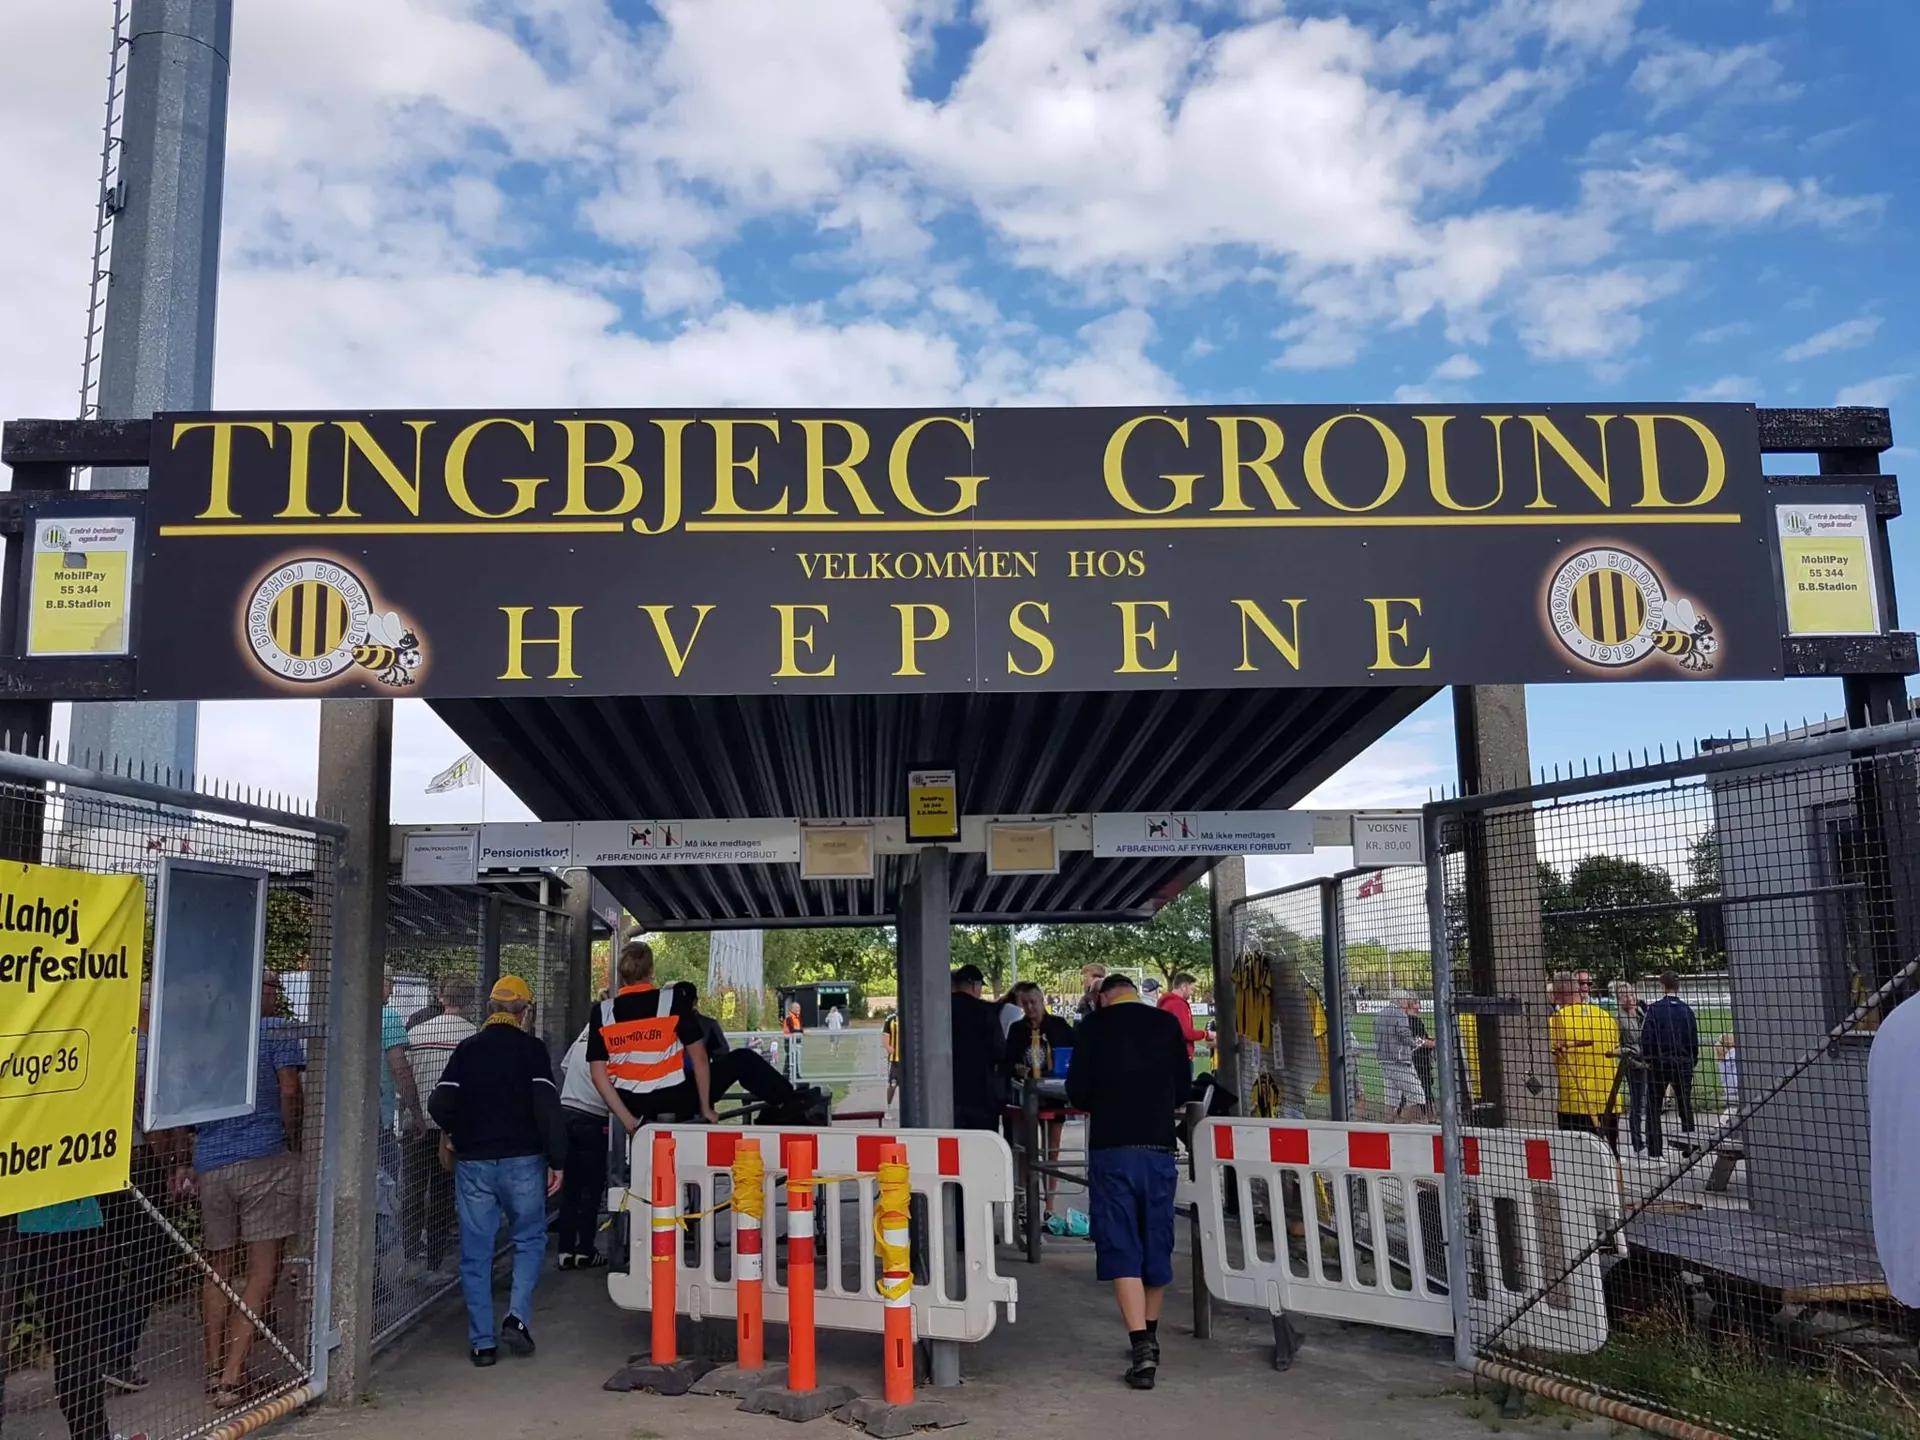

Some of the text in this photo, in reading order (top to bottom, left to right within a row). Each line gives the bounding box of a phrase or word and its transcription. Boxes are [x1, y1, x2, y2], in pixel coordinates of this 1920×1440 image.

[171, 413, 1726, 534] TINGBJERG GROUND
[796, 549, 1145, 580] VELKOMMEN HOS
[1801, 555, 1849, 566] MobilPay
[54, 571, 107, 582] MobilPay
[1809, 568, 1844, 578] 55 344
[60, 585, 98, 595] 55 344
[1797, 582, 1858, 591] B.B.Stadion
[1552, 554, 1598, 635] BRØNSHØJ
[1607, 553, 1663, 632] BOLDKLUB
[45, 600, 111, 609] B.B.Stadion
[252, 565, 304, 650] BRØNSHØJ
[314, 564, 368, 646] BOLDKLUB
[1590, 643, 1635, 662] 1919
[283, 657, 333, 677] 1919
[1367, 823, 1409, 833] VOKSNE
[1215, 831, 1233, 839] ikke
[1234, 831, 1276, 840] medtages
[684, 839, 762, 849] Må ikke medtages
[1116, 842, 1292, 853] AFBRÆNDING AF FYRVÆRKERI FORBUDT
[1365, 840, 1382, 850] KR.
[483, 848, 569, 859] Pensionistkort
[596, 850, 777, 862] AFBRÆNDING AF FYRVÆRKERI FORBUDT
[55, 1047, 78, 1072] 36
[57, 1128, 118, 1167] 2018
